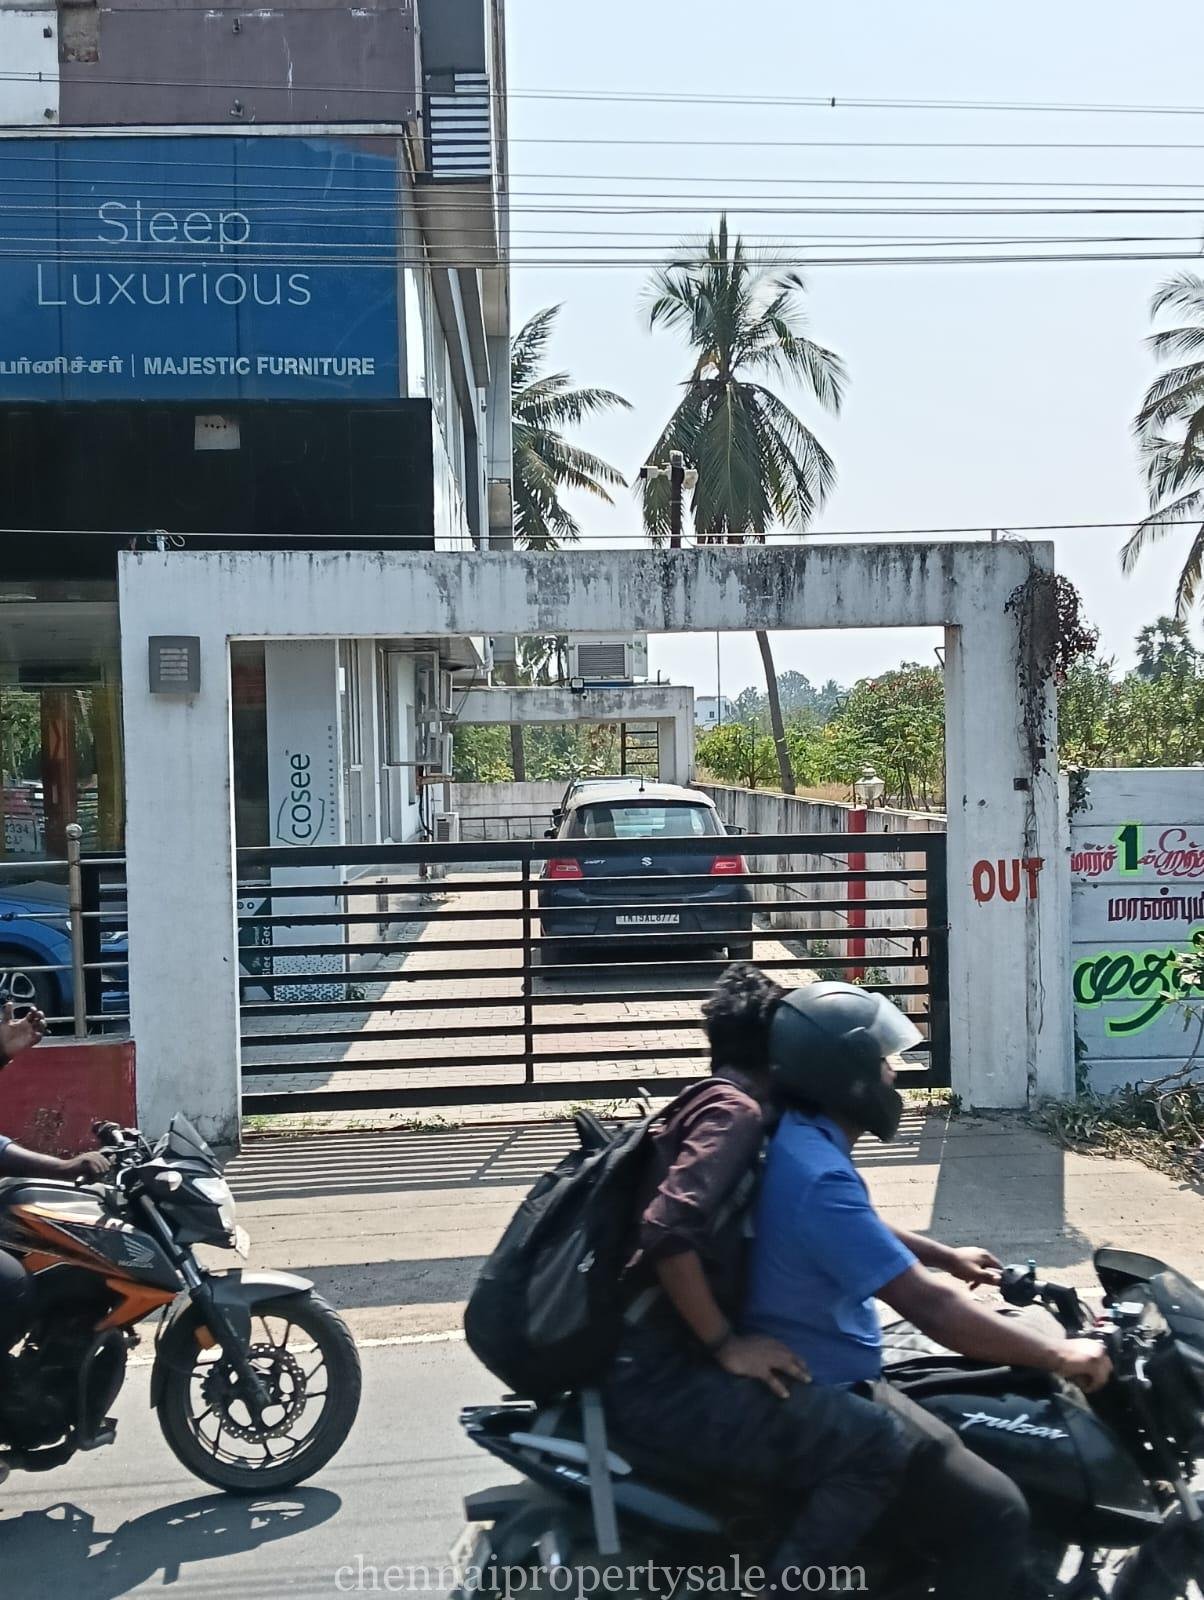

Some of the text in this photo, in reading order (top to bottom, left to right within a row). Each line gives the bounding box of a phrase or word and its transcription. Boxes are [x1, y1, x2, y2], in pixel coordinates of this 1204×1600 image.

[97, 200, 251, 252] Sleep
[37, 262, 311, 306] Luxurious
[144, 356, 375, 376] MAJESTIC FURNITURE
[290, 753, 312, 839] cosee
[972, 857, 1045, 903] OUT
